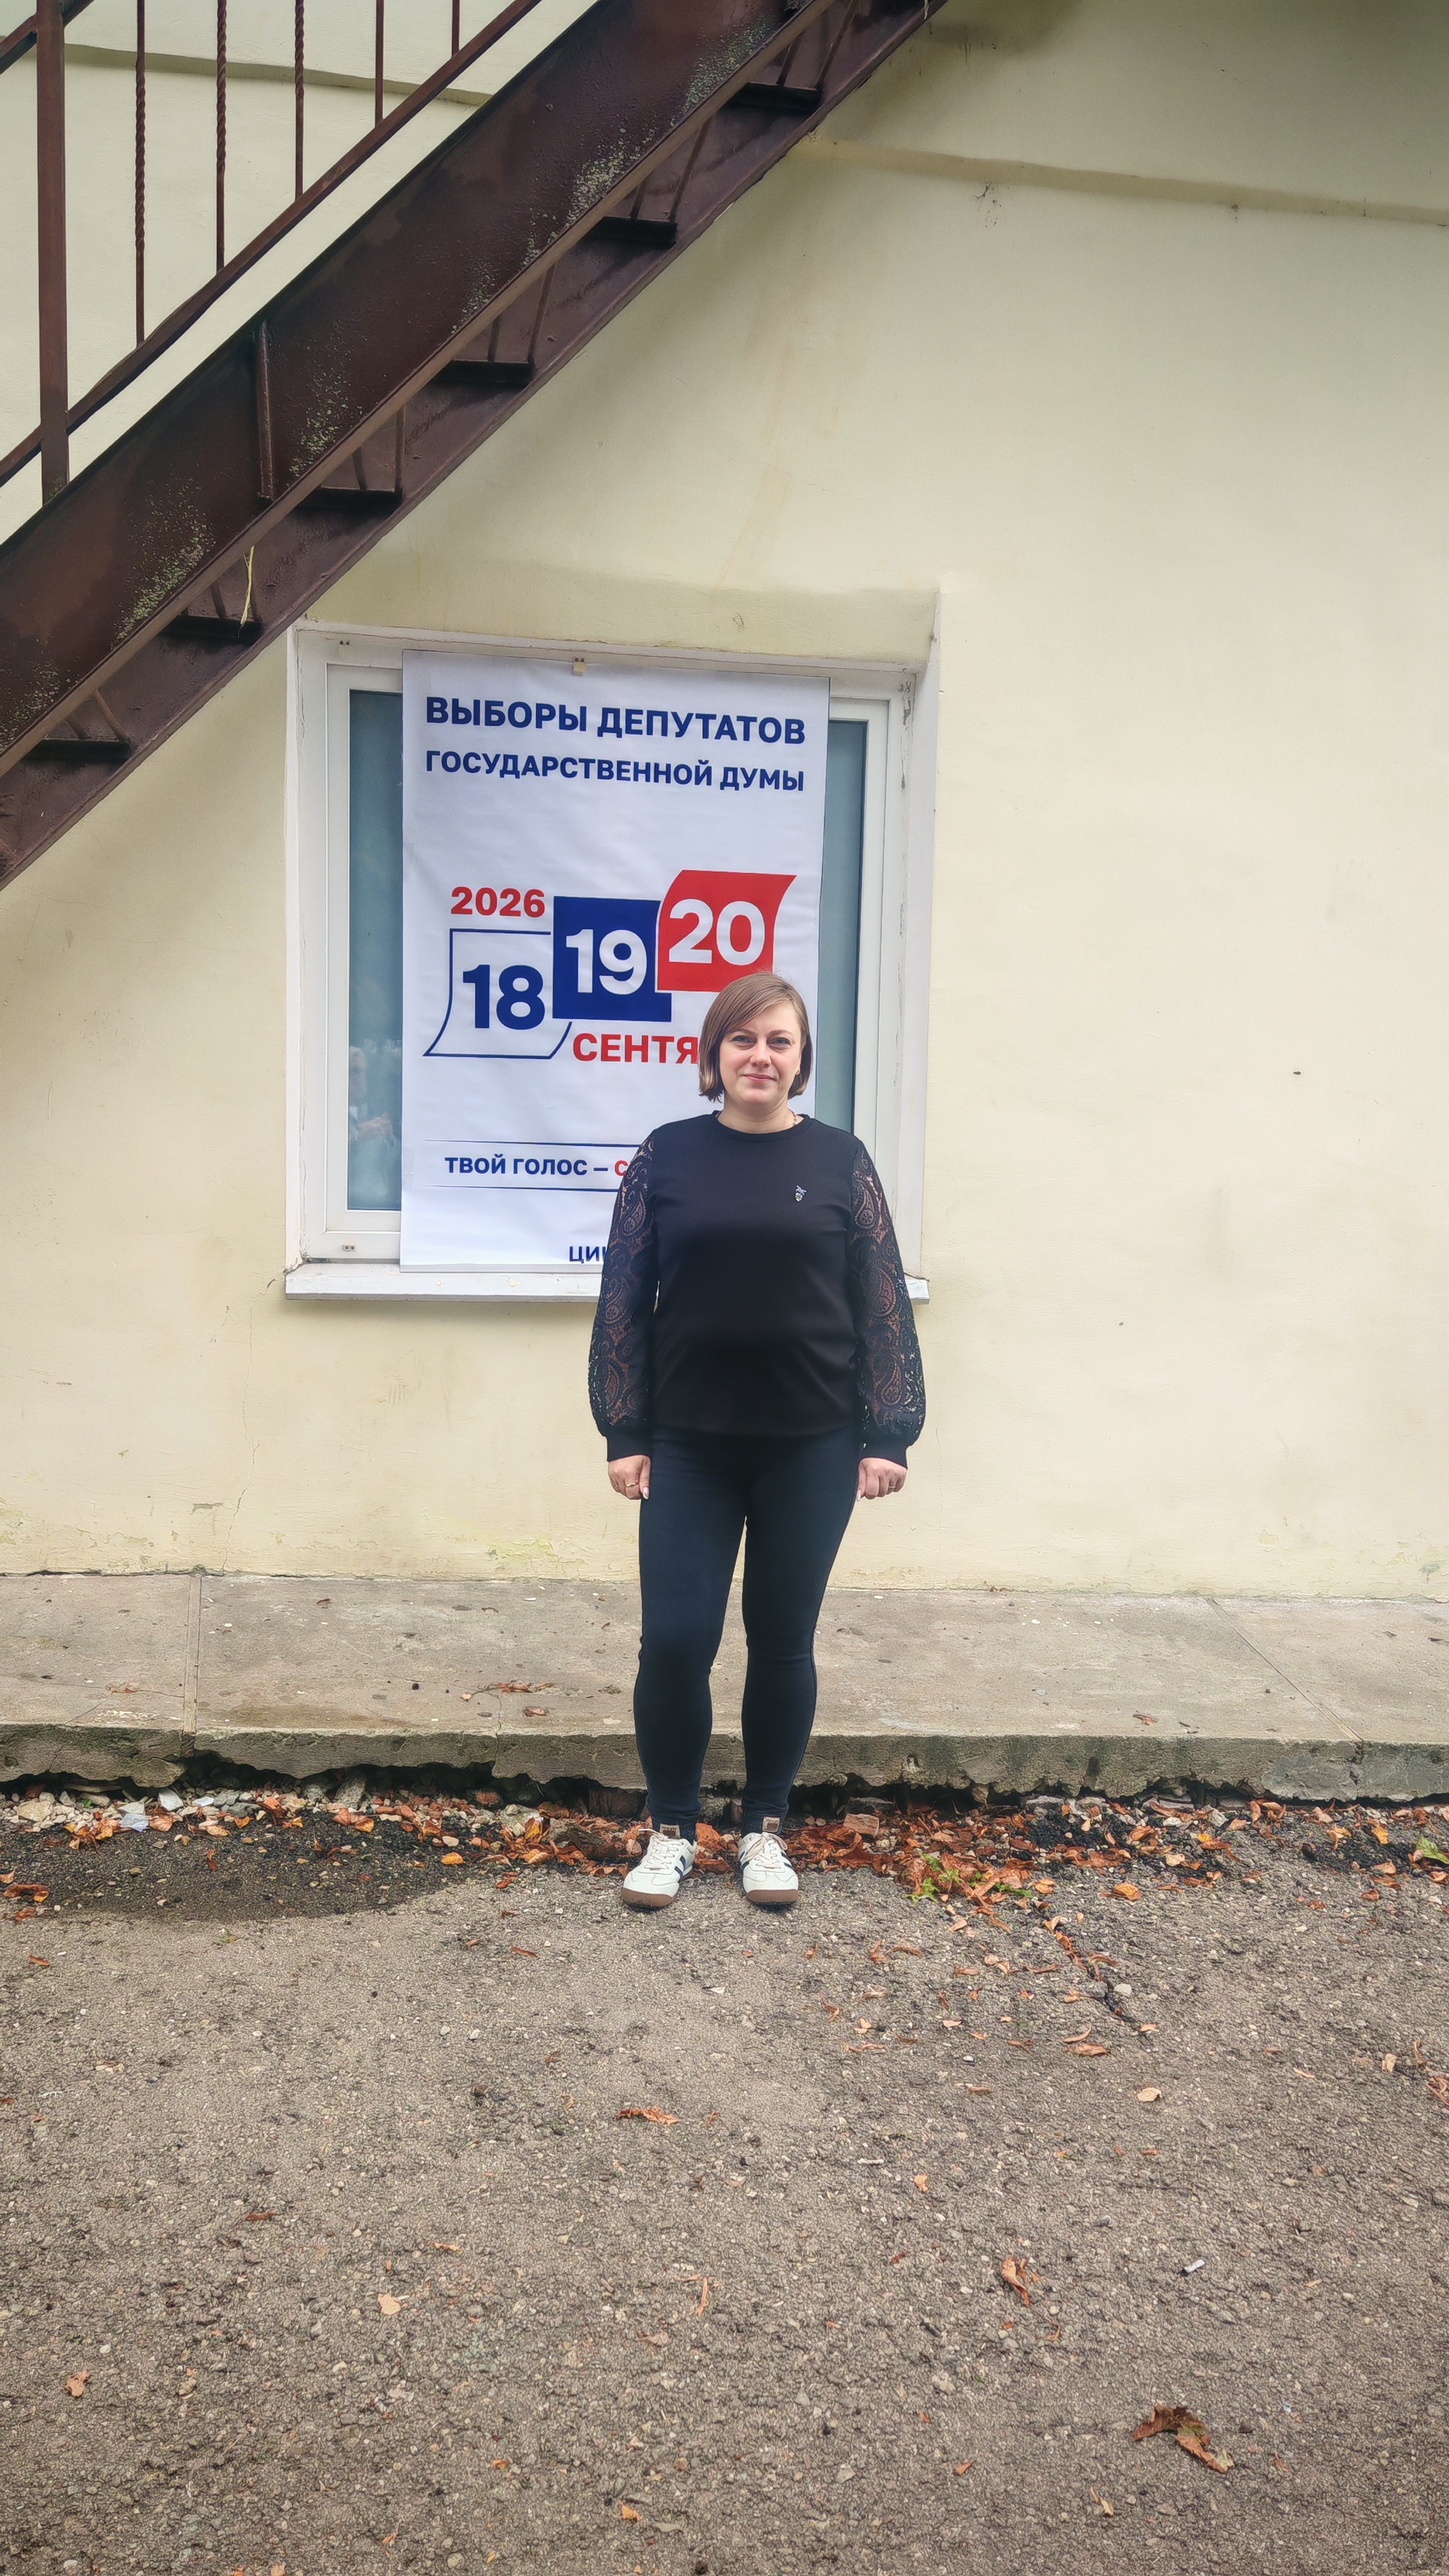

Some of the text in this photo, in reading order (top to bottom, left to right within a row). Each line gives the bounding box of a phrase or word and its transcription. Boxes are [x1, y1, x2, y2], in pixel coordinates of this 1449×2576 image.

[426, 696, 806, 745] ВЫБОРЫ ДЕПУТАТОВ
[426, 750, 804, 792] ГОСУДАРСТВЕННОЙ ДУМЫ
[451, 886, 545, 917] 2026
[462, 899, 765, 1030] 18 19 20
[573, 1033, 699, 1064] СЕНТЯ
[444, 1153, 506, 1174] ТВОЙ
[513, 1158, 587, 1175] ГОЛОС
